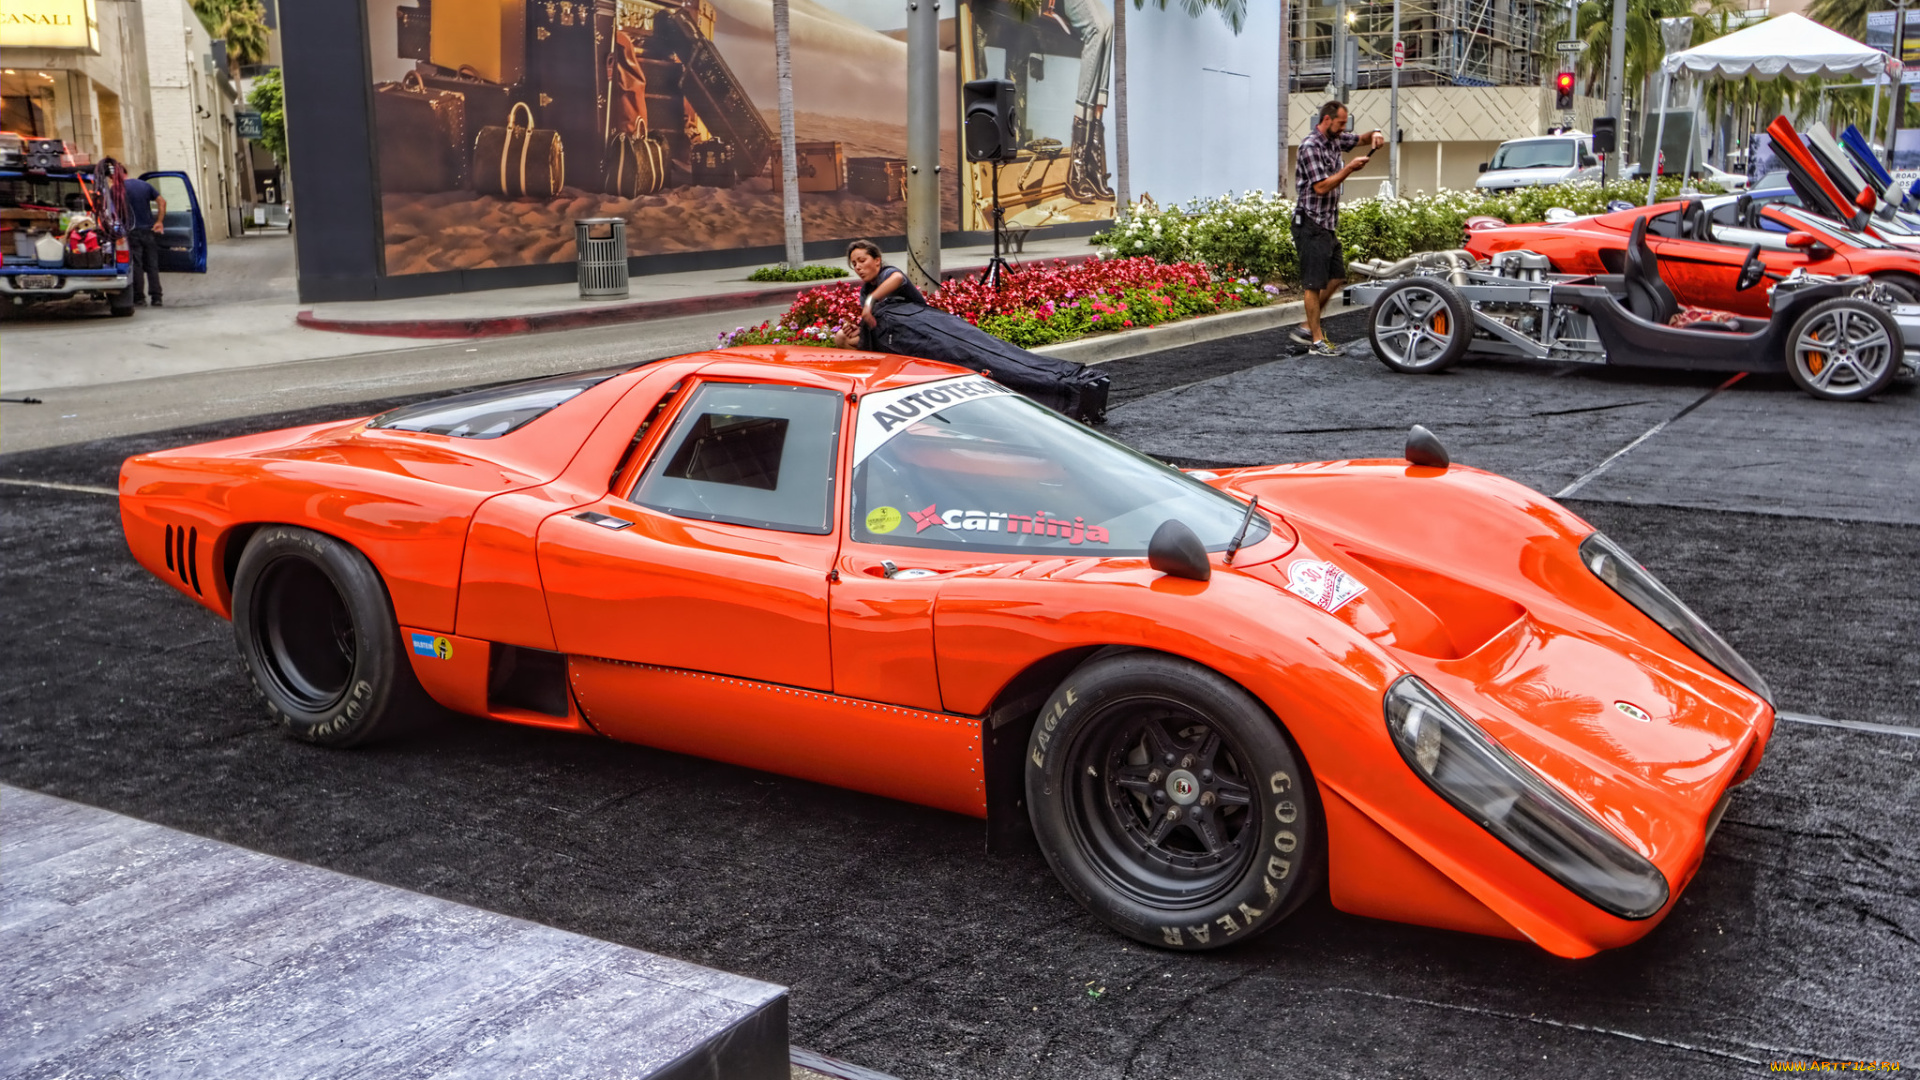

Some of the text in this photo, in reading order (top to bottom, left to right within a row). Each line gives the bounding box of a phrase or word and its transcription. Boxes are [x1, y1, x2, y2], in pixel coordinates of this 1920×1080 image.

[942, 509, 1109, 544] carninja
[1301, 568, 1322, 582] 30
[1031, 686, 1078, 769] EAGLE
[1160, 770, 1298, 946] GOODYEAR
